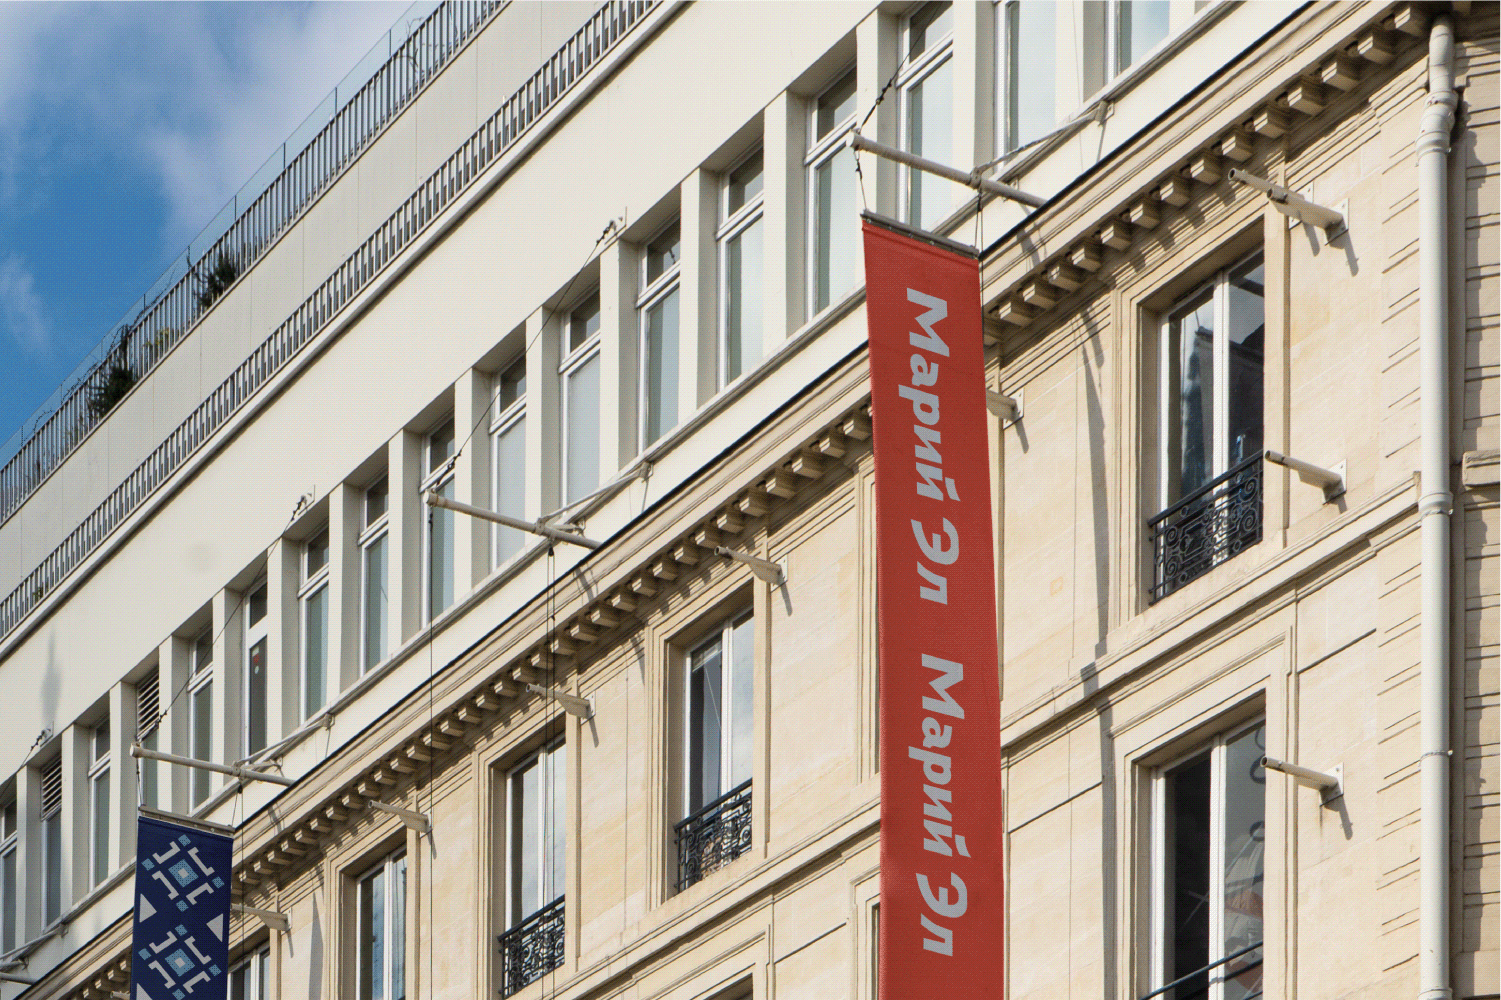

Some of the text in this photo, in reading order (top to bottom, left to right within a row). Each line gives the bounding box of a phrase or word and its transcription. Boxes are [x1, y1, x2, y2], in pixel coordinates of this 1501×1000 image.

[899, 288, 960, 501] Марий
[911, 518, 959, 604] Эл
[909, 654, 970, 857] Марий
[916, 873, 967, 956] Эл
